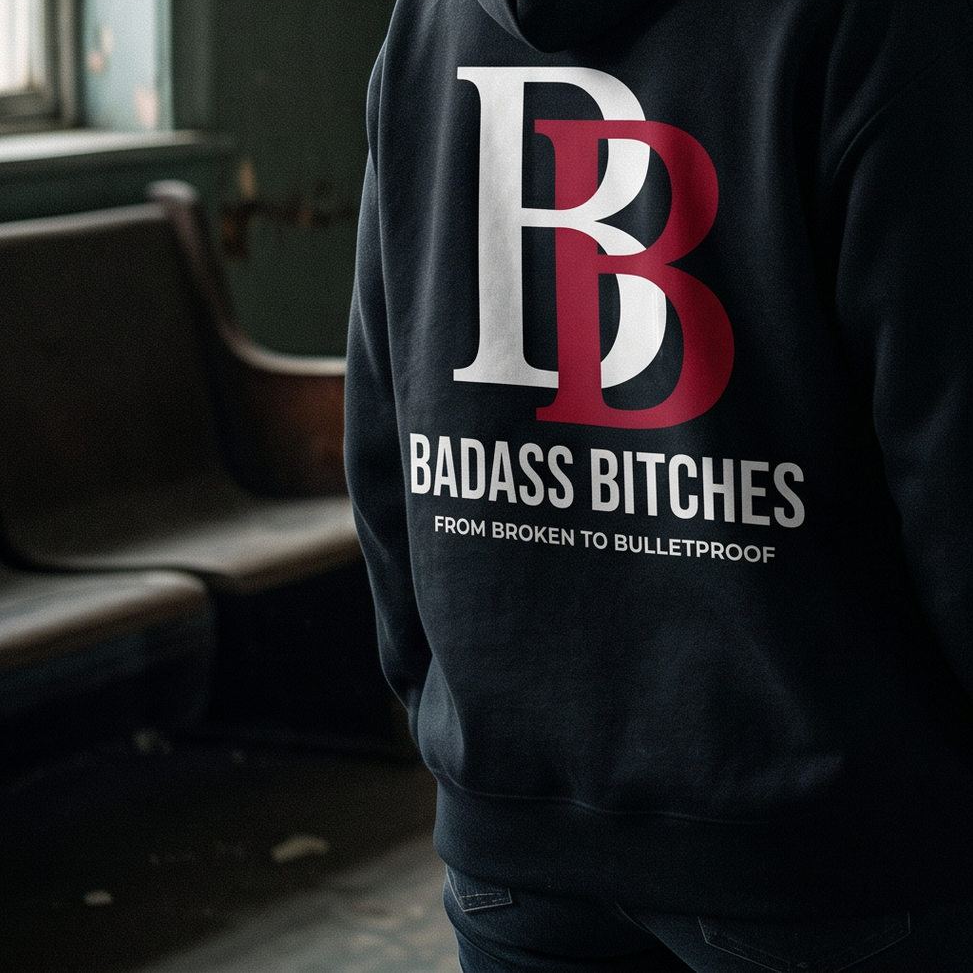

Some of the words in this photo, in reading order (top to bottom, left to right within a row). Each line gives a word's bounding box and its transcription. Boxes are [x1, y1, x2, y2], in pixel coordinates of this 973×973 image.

[410, 432, 575, 509] BADASS
[590, 448, 806, 528] BITCHES
[434, 515, 486, 538] FROM
[491, 521, 575, 547] BROKEN
[580, 530, 608, 550] TO
[614, 534, 776, 564] BULLETPROOF
